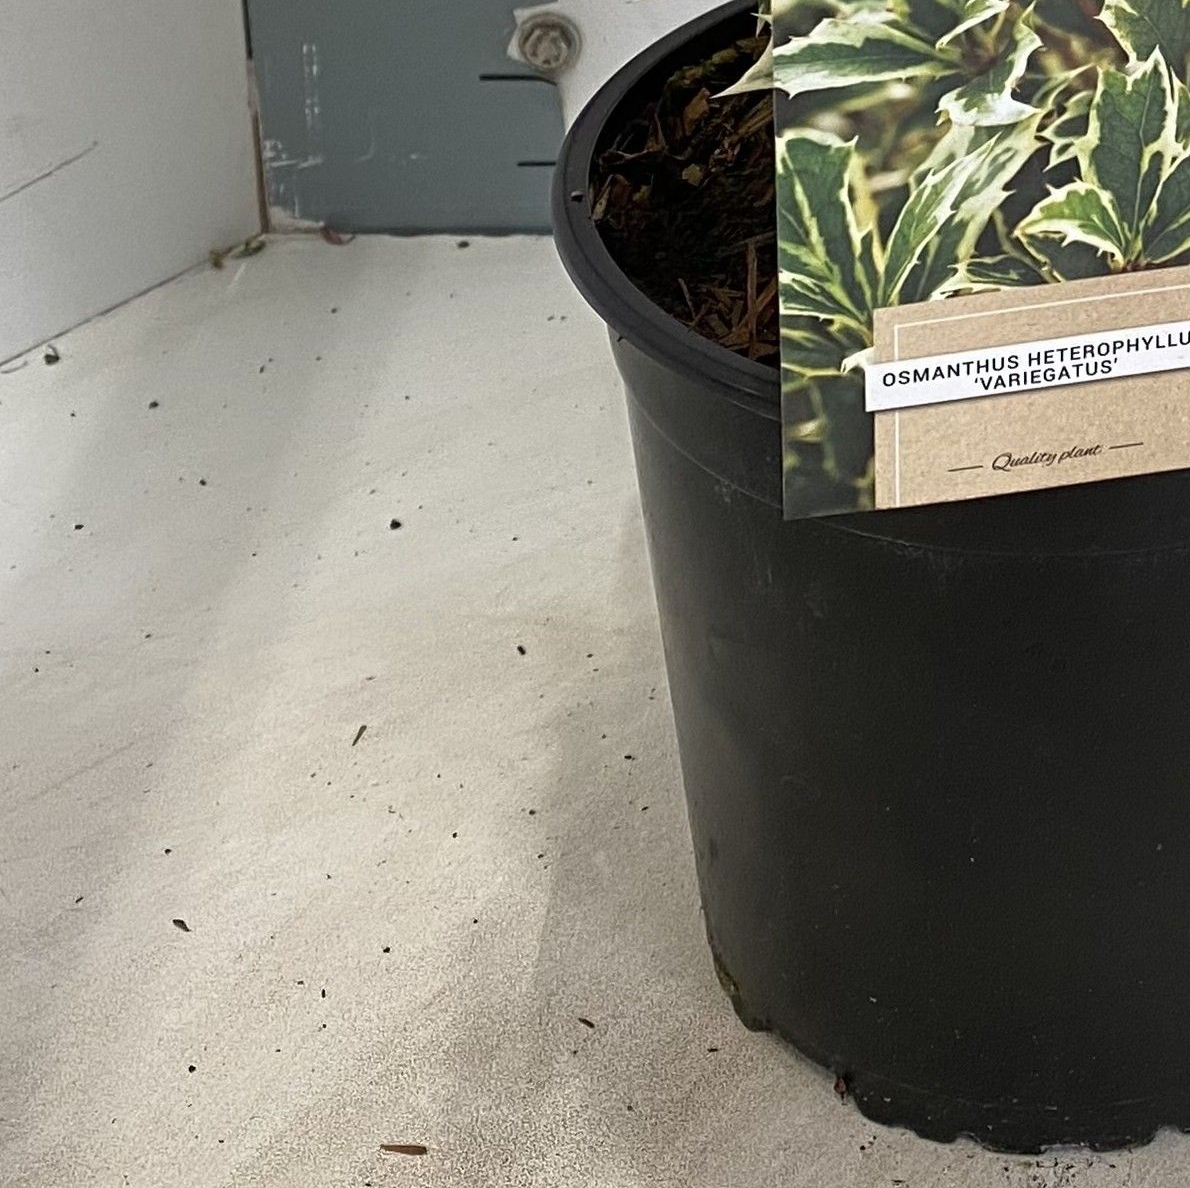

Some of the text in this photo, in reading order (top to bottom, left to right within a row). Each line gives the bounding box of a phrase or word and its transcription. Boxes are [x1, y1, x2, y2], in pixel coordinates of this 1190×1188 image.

[882, 354, 1020, 388] OSMANTHUS
[974, 358, 1119, 392] 'VARIEGATUS'
[991, 444, 1102, 473] Quality plant
